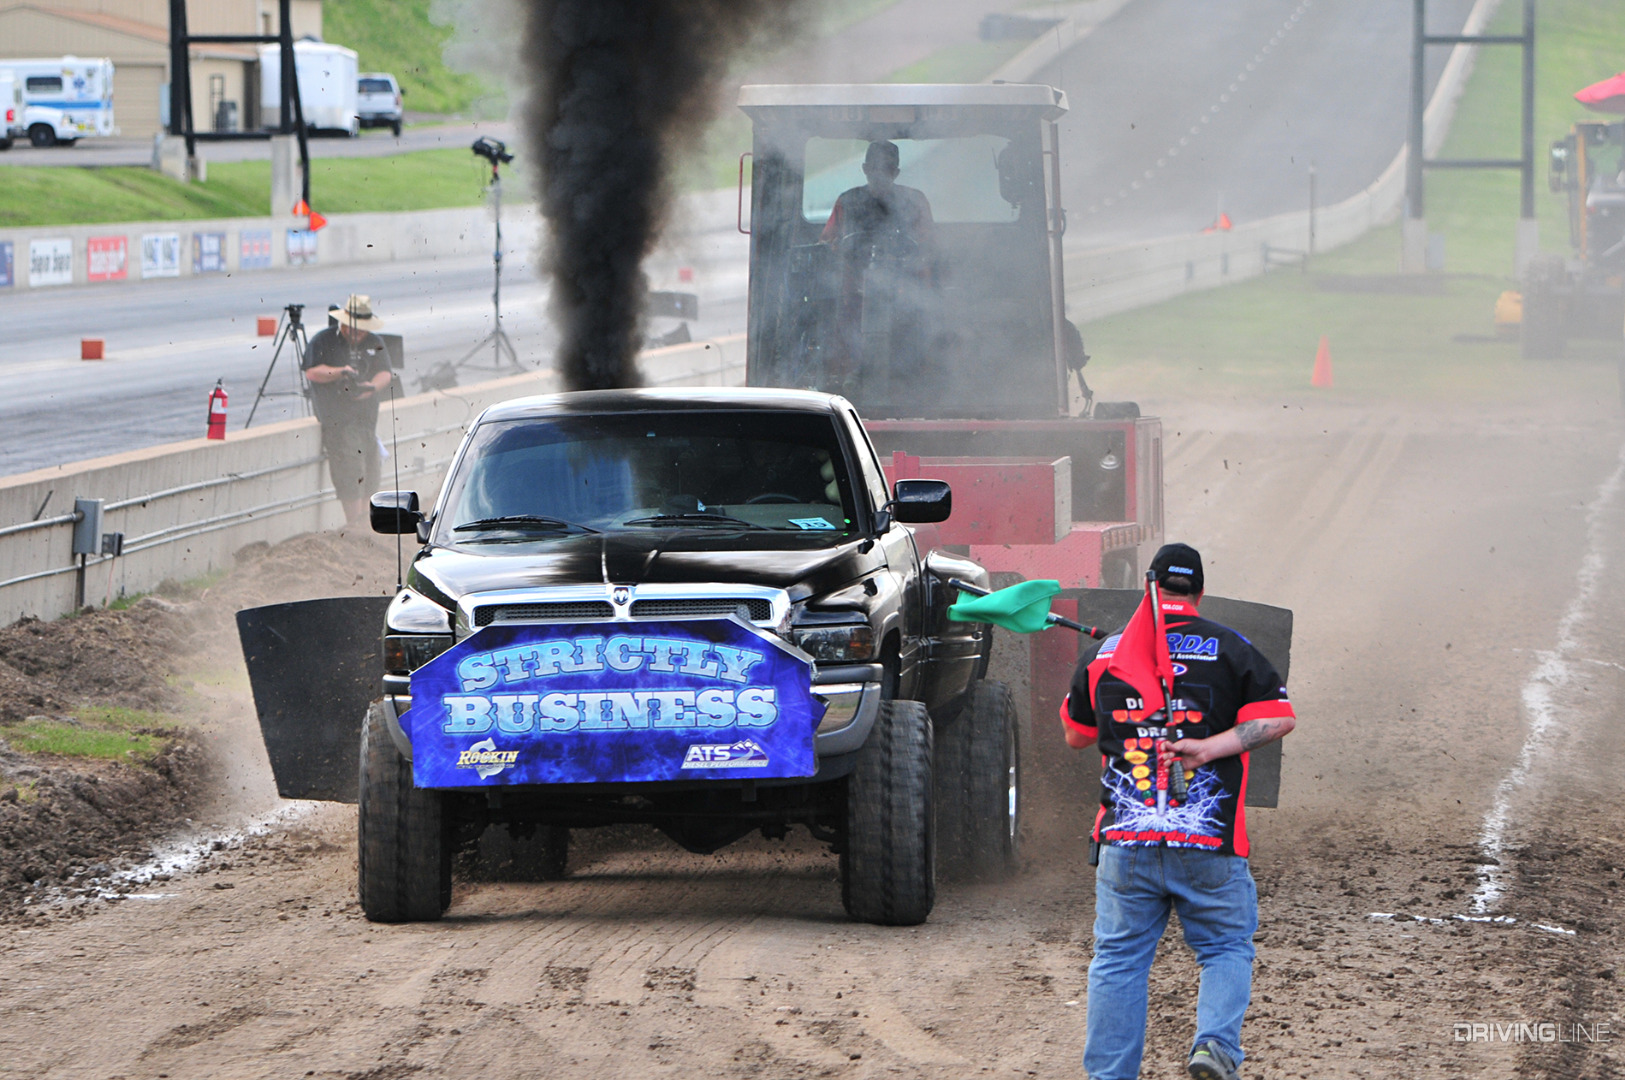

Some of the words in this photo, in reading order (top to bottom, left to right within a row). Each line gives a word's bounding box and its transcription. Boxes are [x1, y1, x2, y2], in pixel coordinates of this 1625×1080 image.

[1166, 633, 1218, 656] RDA
[458, 635, 764, 691] STRICTLY
[443, 688, 778, 734] BUSINESS
[1126, 698, 1187, 710] DIEL
[1136, 727, 1184, 738] DRAS
[456, 750, 520, 765] ROCKIN
[686, 745, 731, 762] ATS
[683, 761, 710, 769] DIESEL
[710, 759, 768, 768] PERFORMANCE
